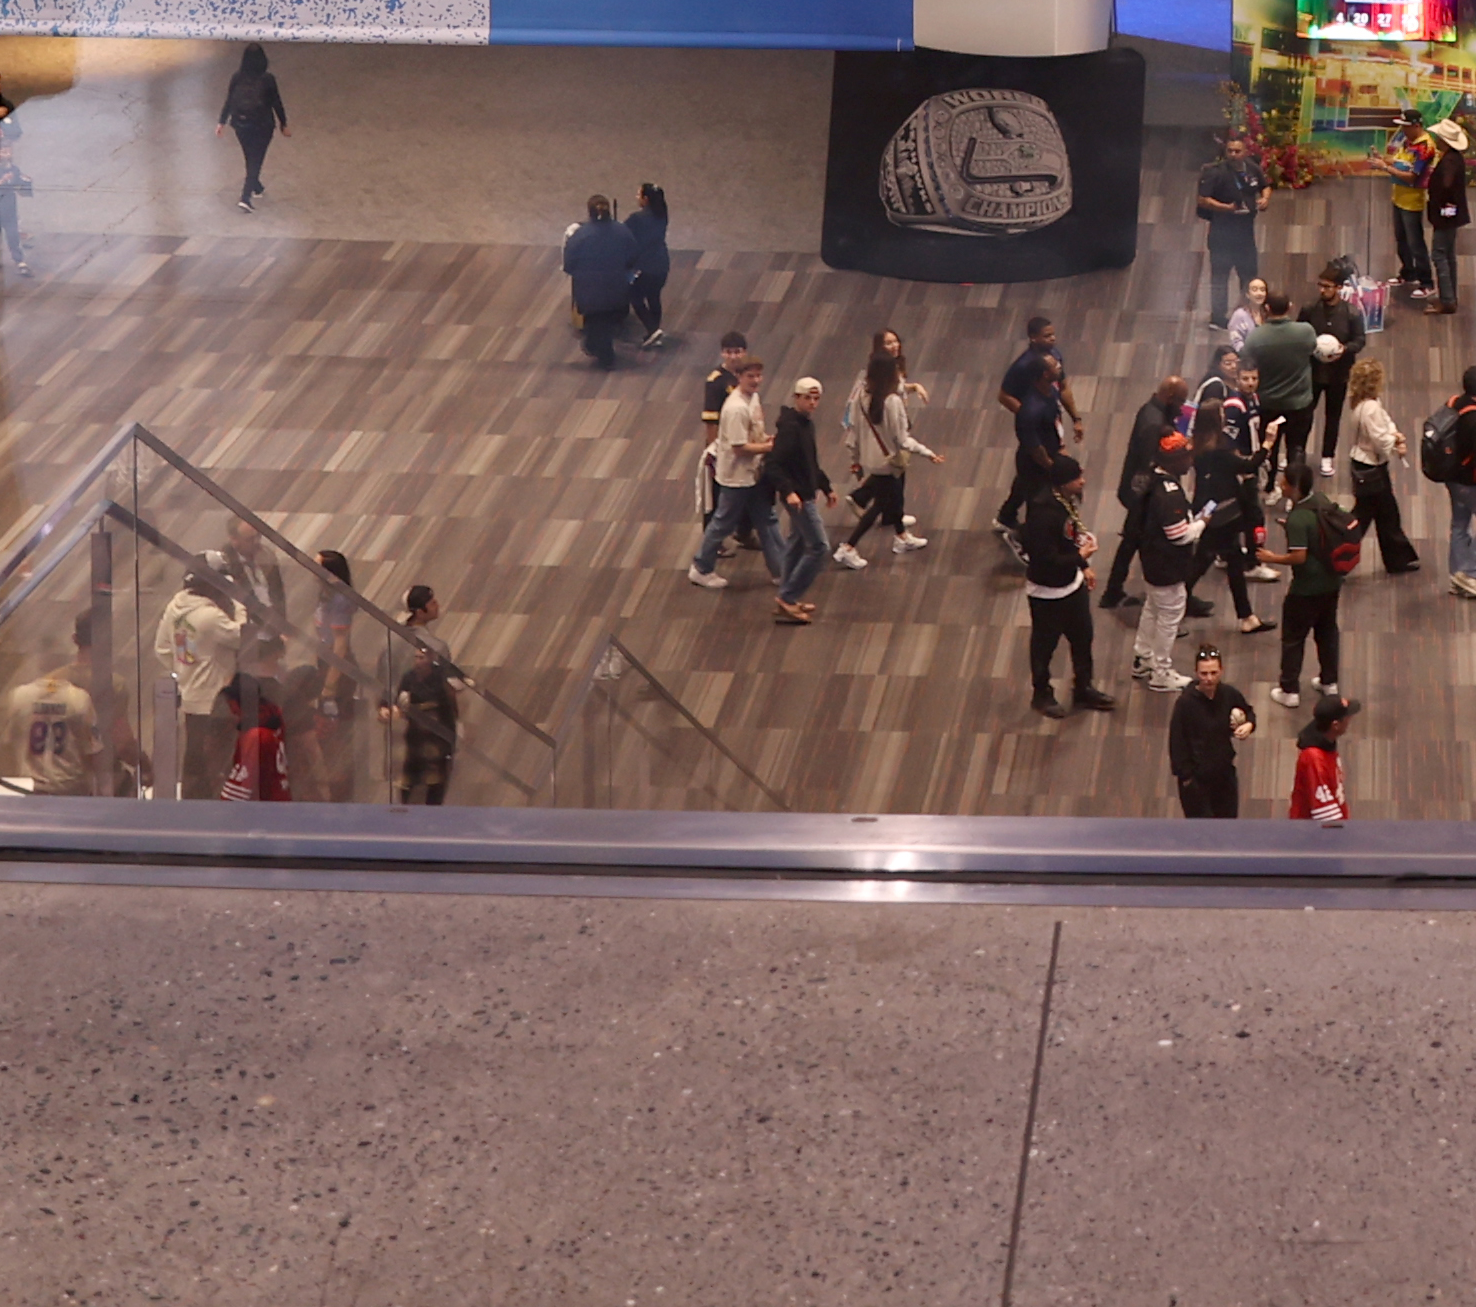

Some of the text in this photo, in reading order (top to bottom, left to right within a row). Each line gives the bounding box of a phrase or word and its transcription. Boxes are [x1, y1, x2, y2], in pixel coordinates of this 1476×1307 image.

[1353, 12, 1369, 24] 20
[1377, 12, 1393, 24] 27
[962, 192, 1069, 218] CHAMPIONS
